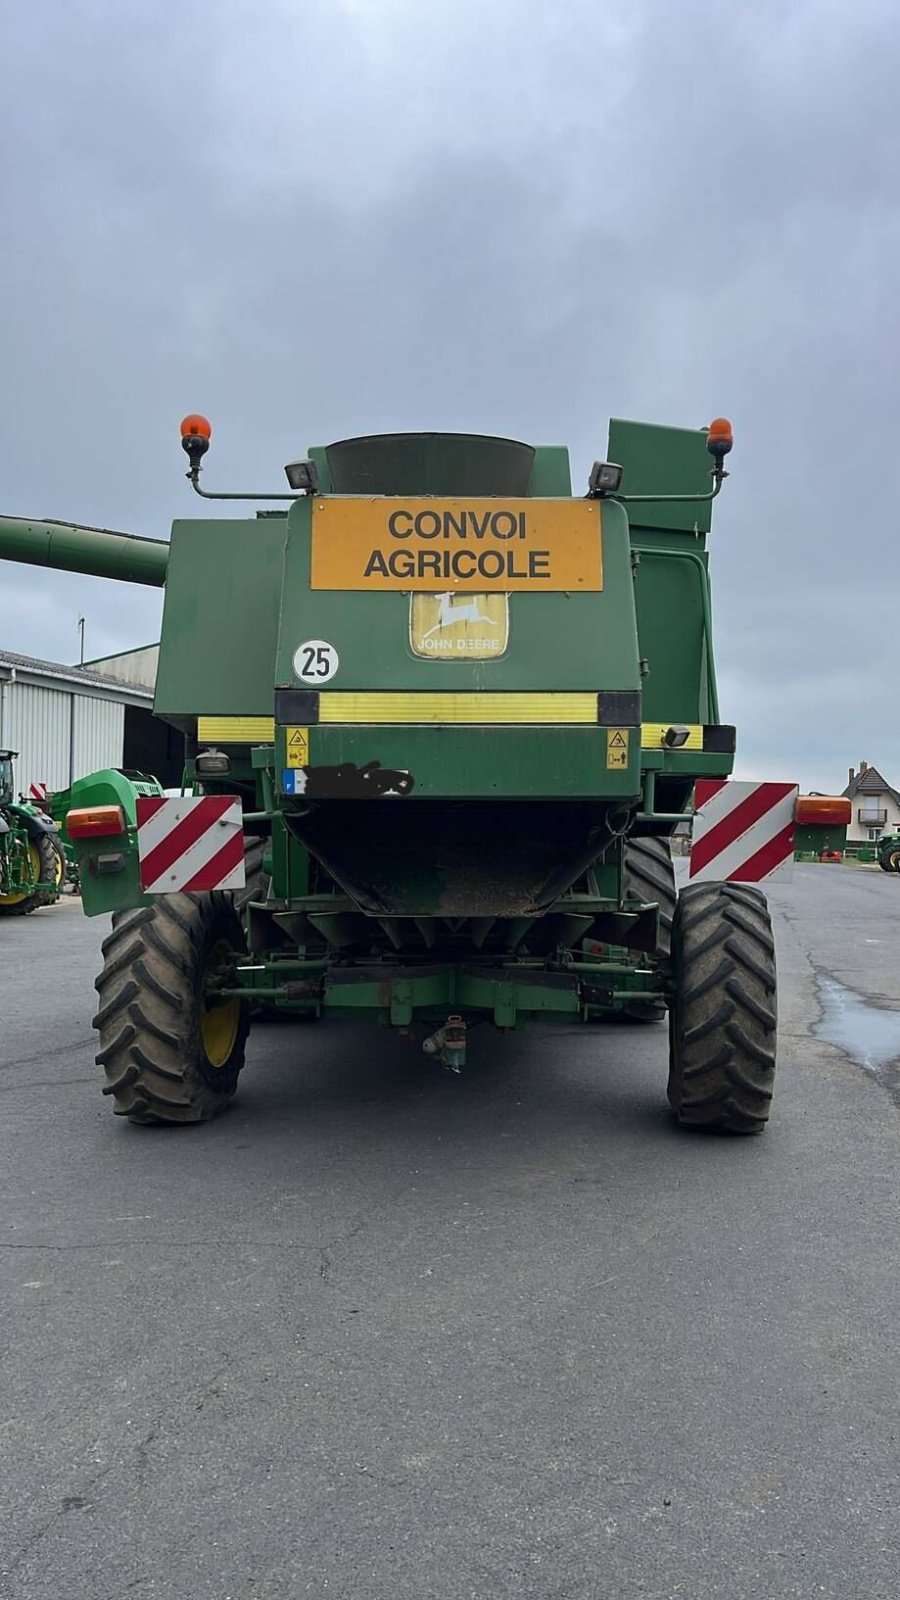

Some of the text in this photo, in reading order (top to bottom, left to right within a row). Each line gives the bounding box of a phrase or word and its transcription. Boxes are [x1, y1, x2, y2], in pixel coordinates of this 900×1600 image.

[388, 510, 526, 539] CONVOI
[363, 549, 551, 578] AGRICOLE
[417, 639, 500, 649] JOHN DEERE
[302, 647, 330, 676] 25
